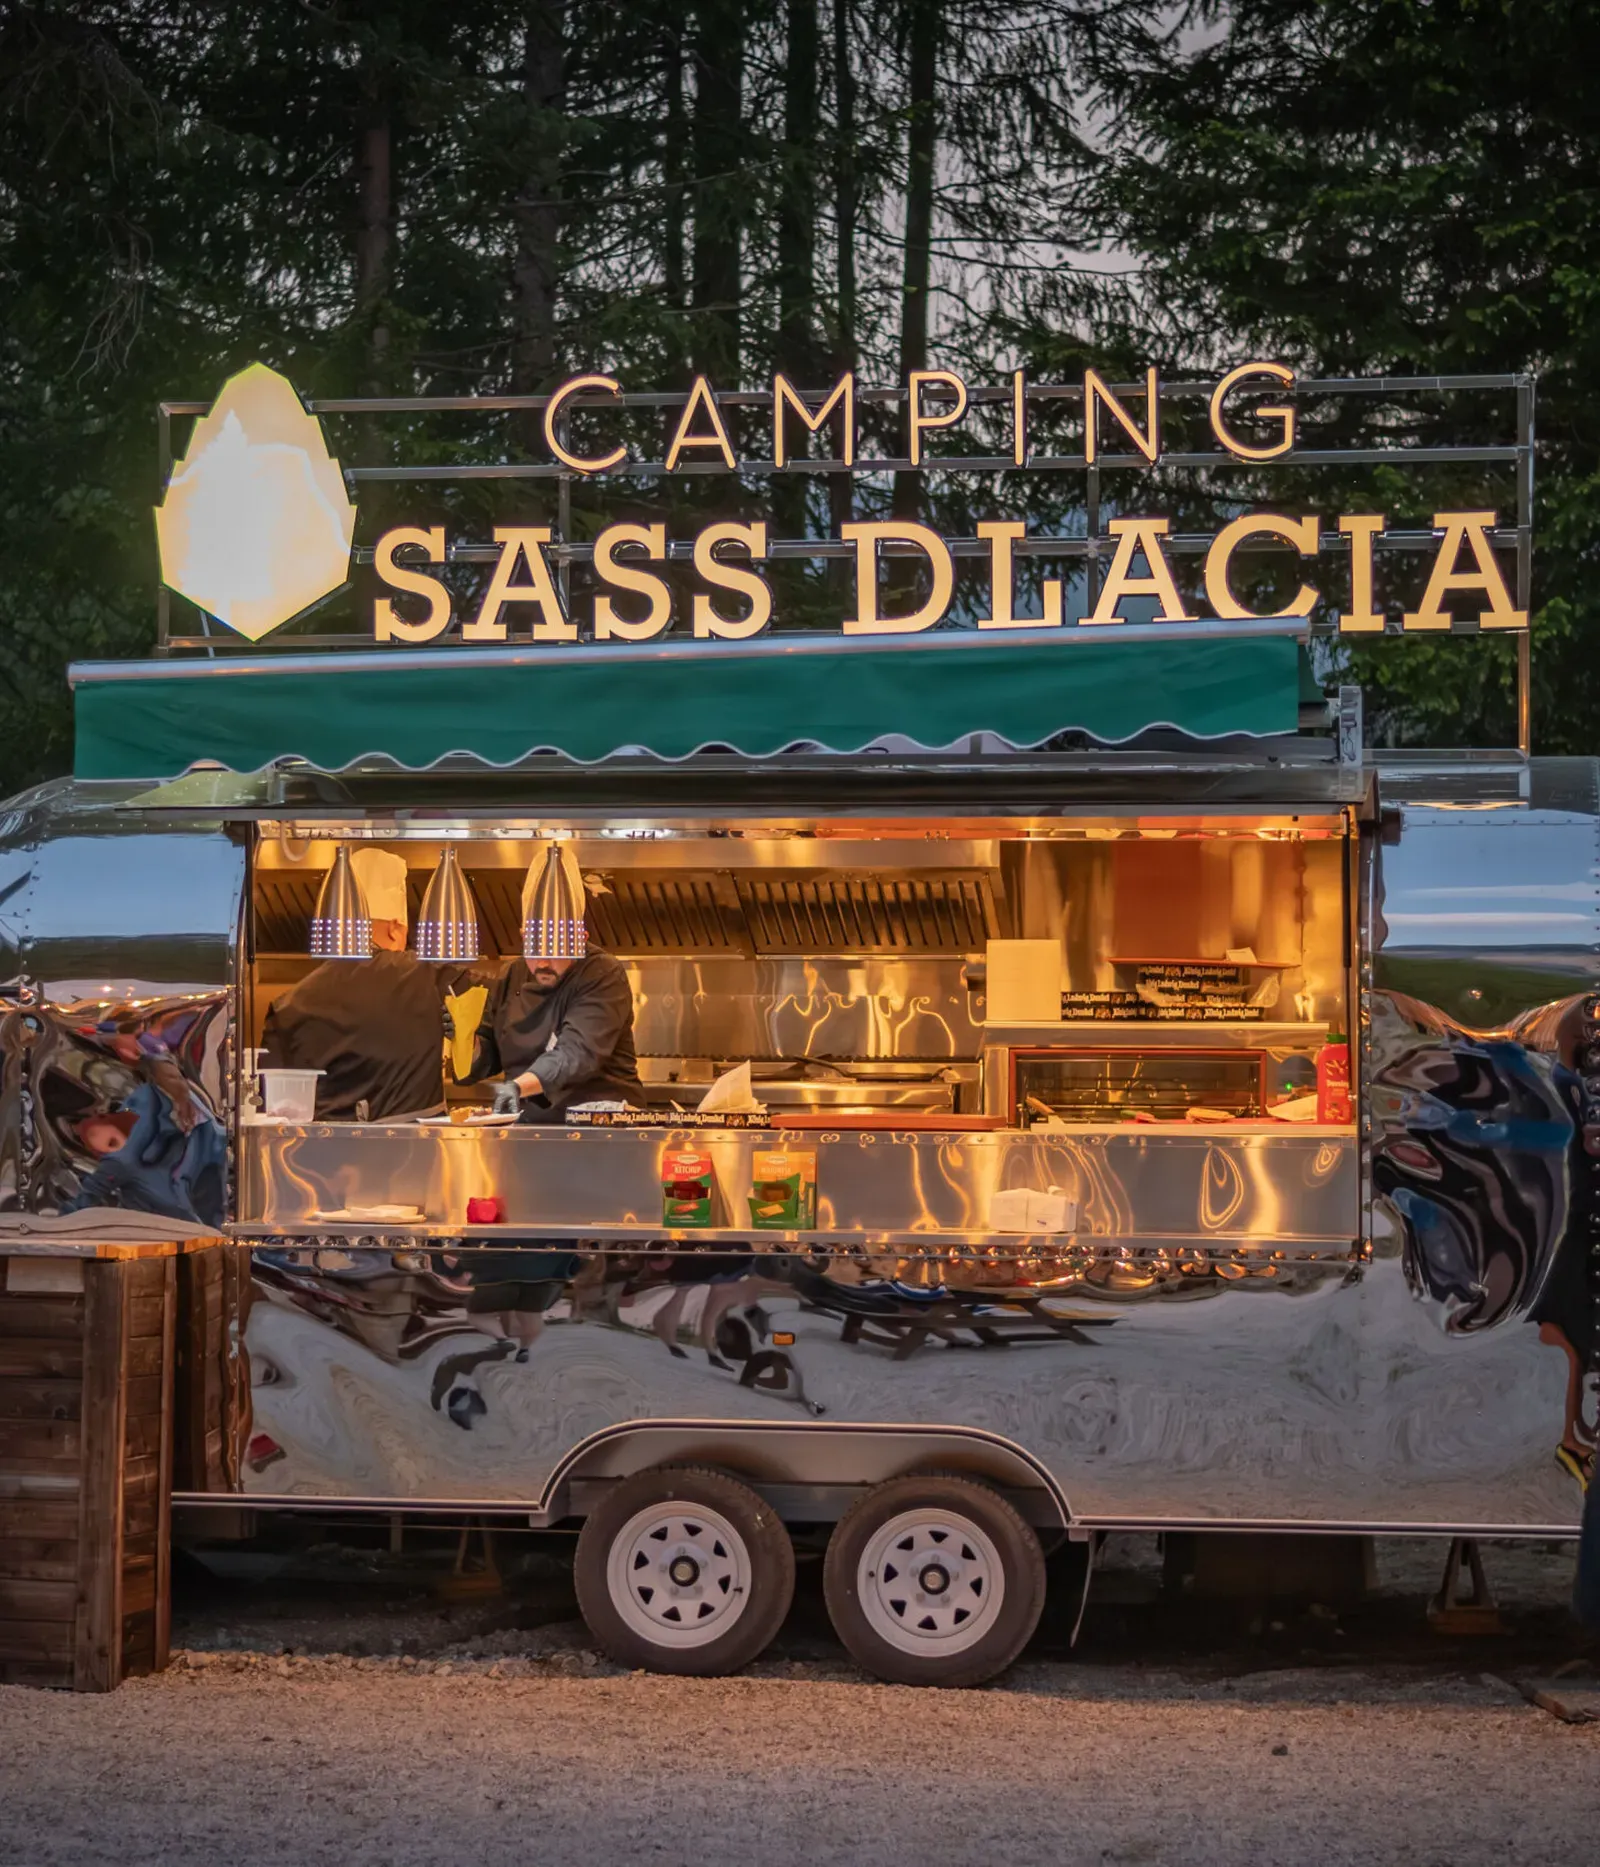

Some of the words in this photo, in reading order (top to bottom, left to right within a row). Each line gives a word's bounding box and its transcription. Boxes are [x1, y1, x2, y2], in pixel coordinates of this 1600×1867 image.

[545, 362, 1296, 471] CAMPING
[374, 522, 774, 642] SASS
[841, 511, 1529, 635] DLACIA
[674, 1165, 702, 1175] KETCHUP
